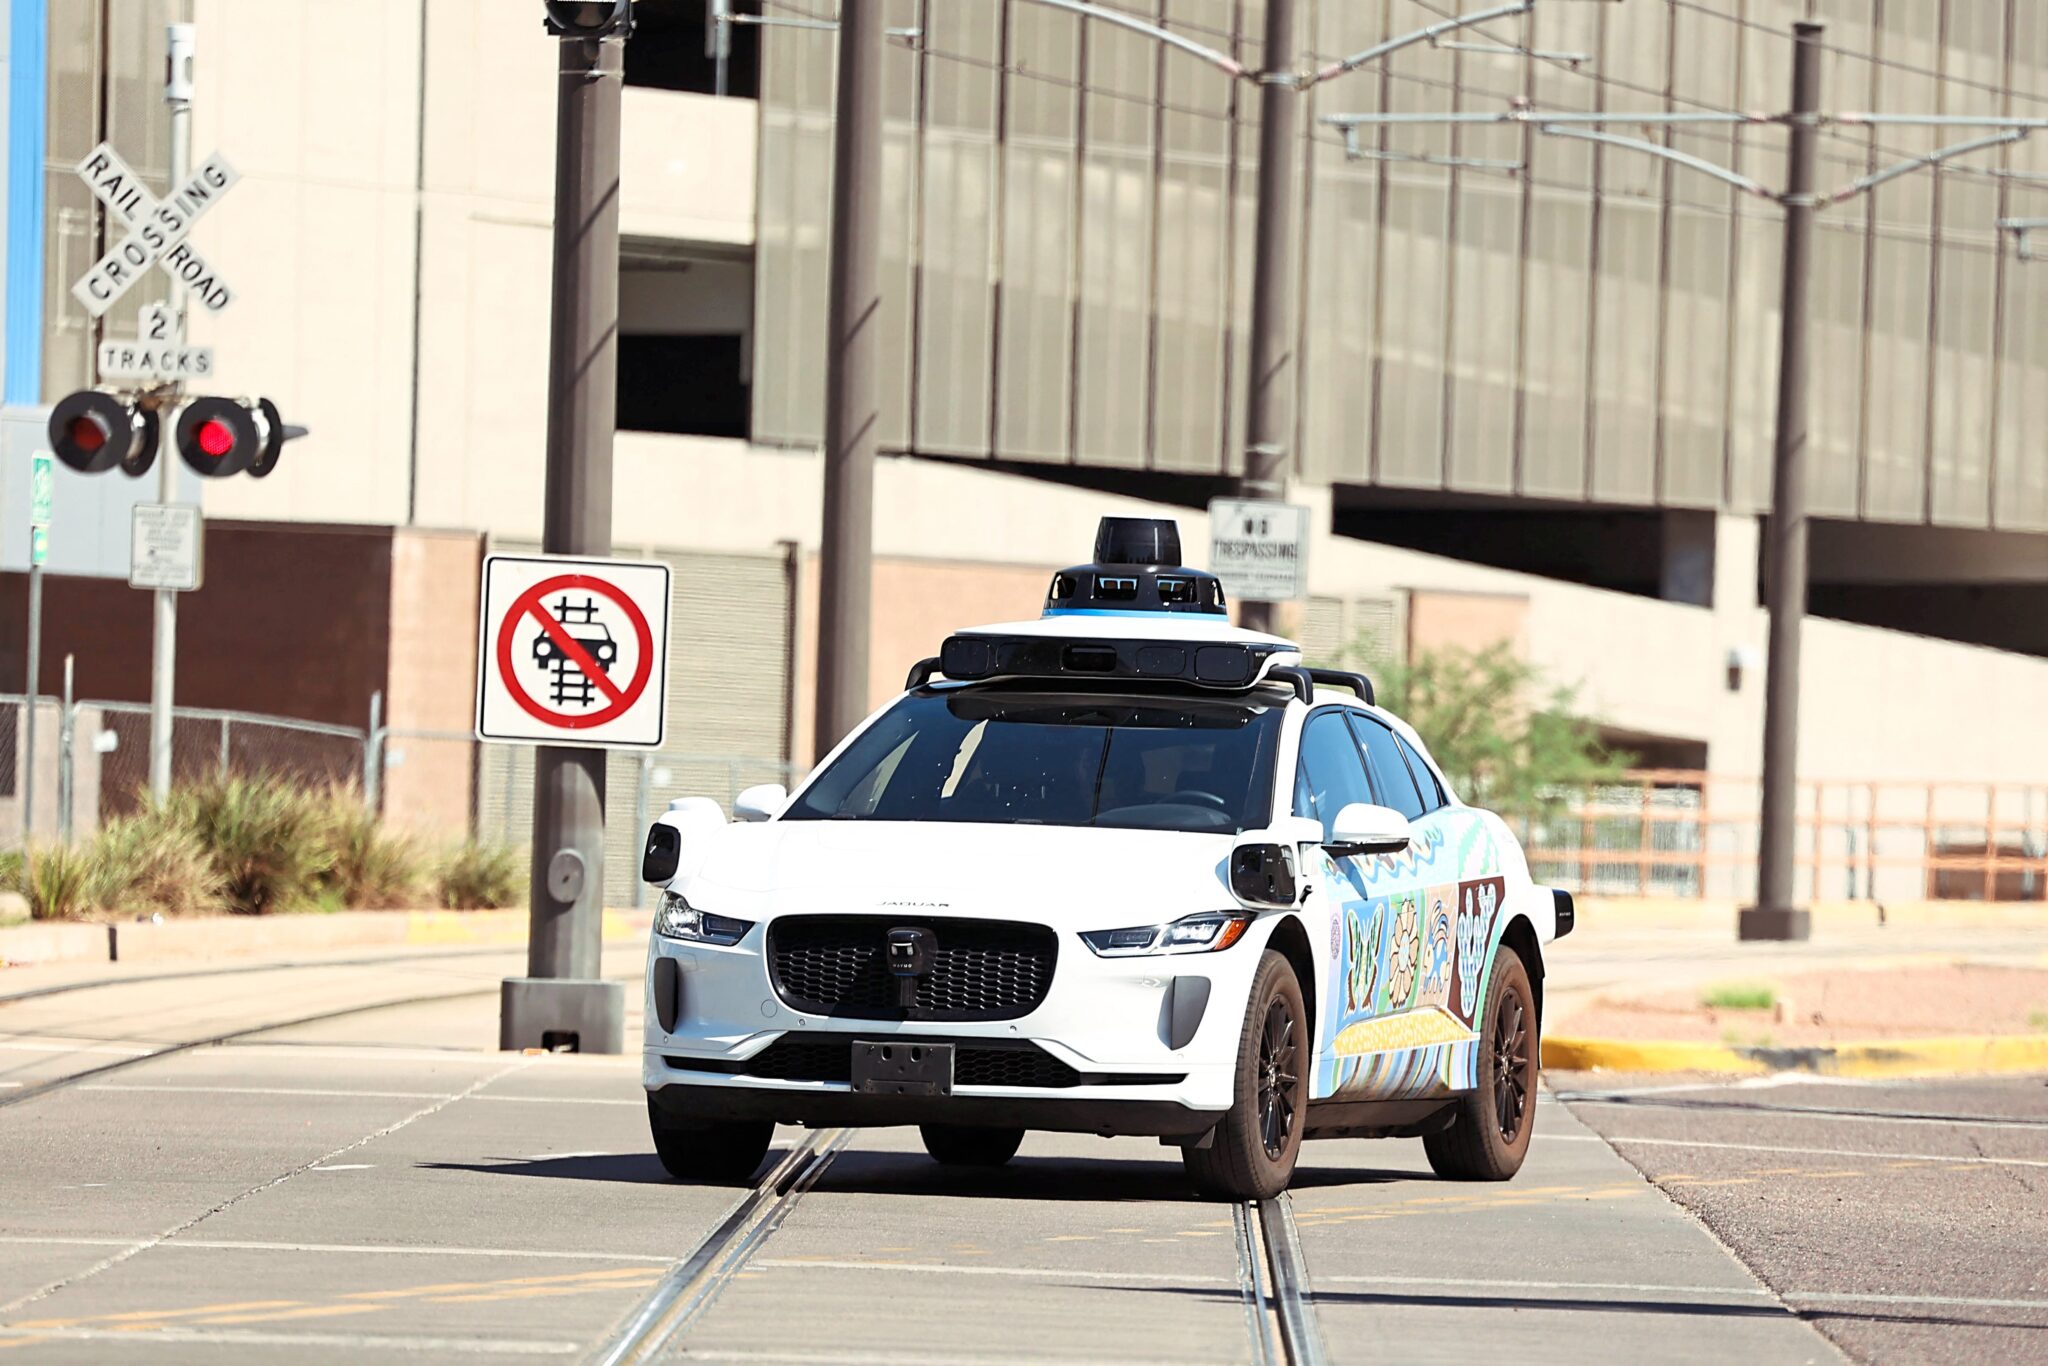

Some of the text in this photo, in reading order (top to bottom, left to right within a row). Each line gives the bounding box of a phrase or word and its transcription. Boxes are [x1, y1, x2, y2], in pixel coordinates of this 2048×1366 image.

[85, 153, 229, 311] RAIL ROAD
[88, 165, 227, 301] CROSSING
[150, 309, 166, 340] 2
[104, 349, 211, 374] TRACKS
[1213, 539, 1299, 561] TRESPASSING
